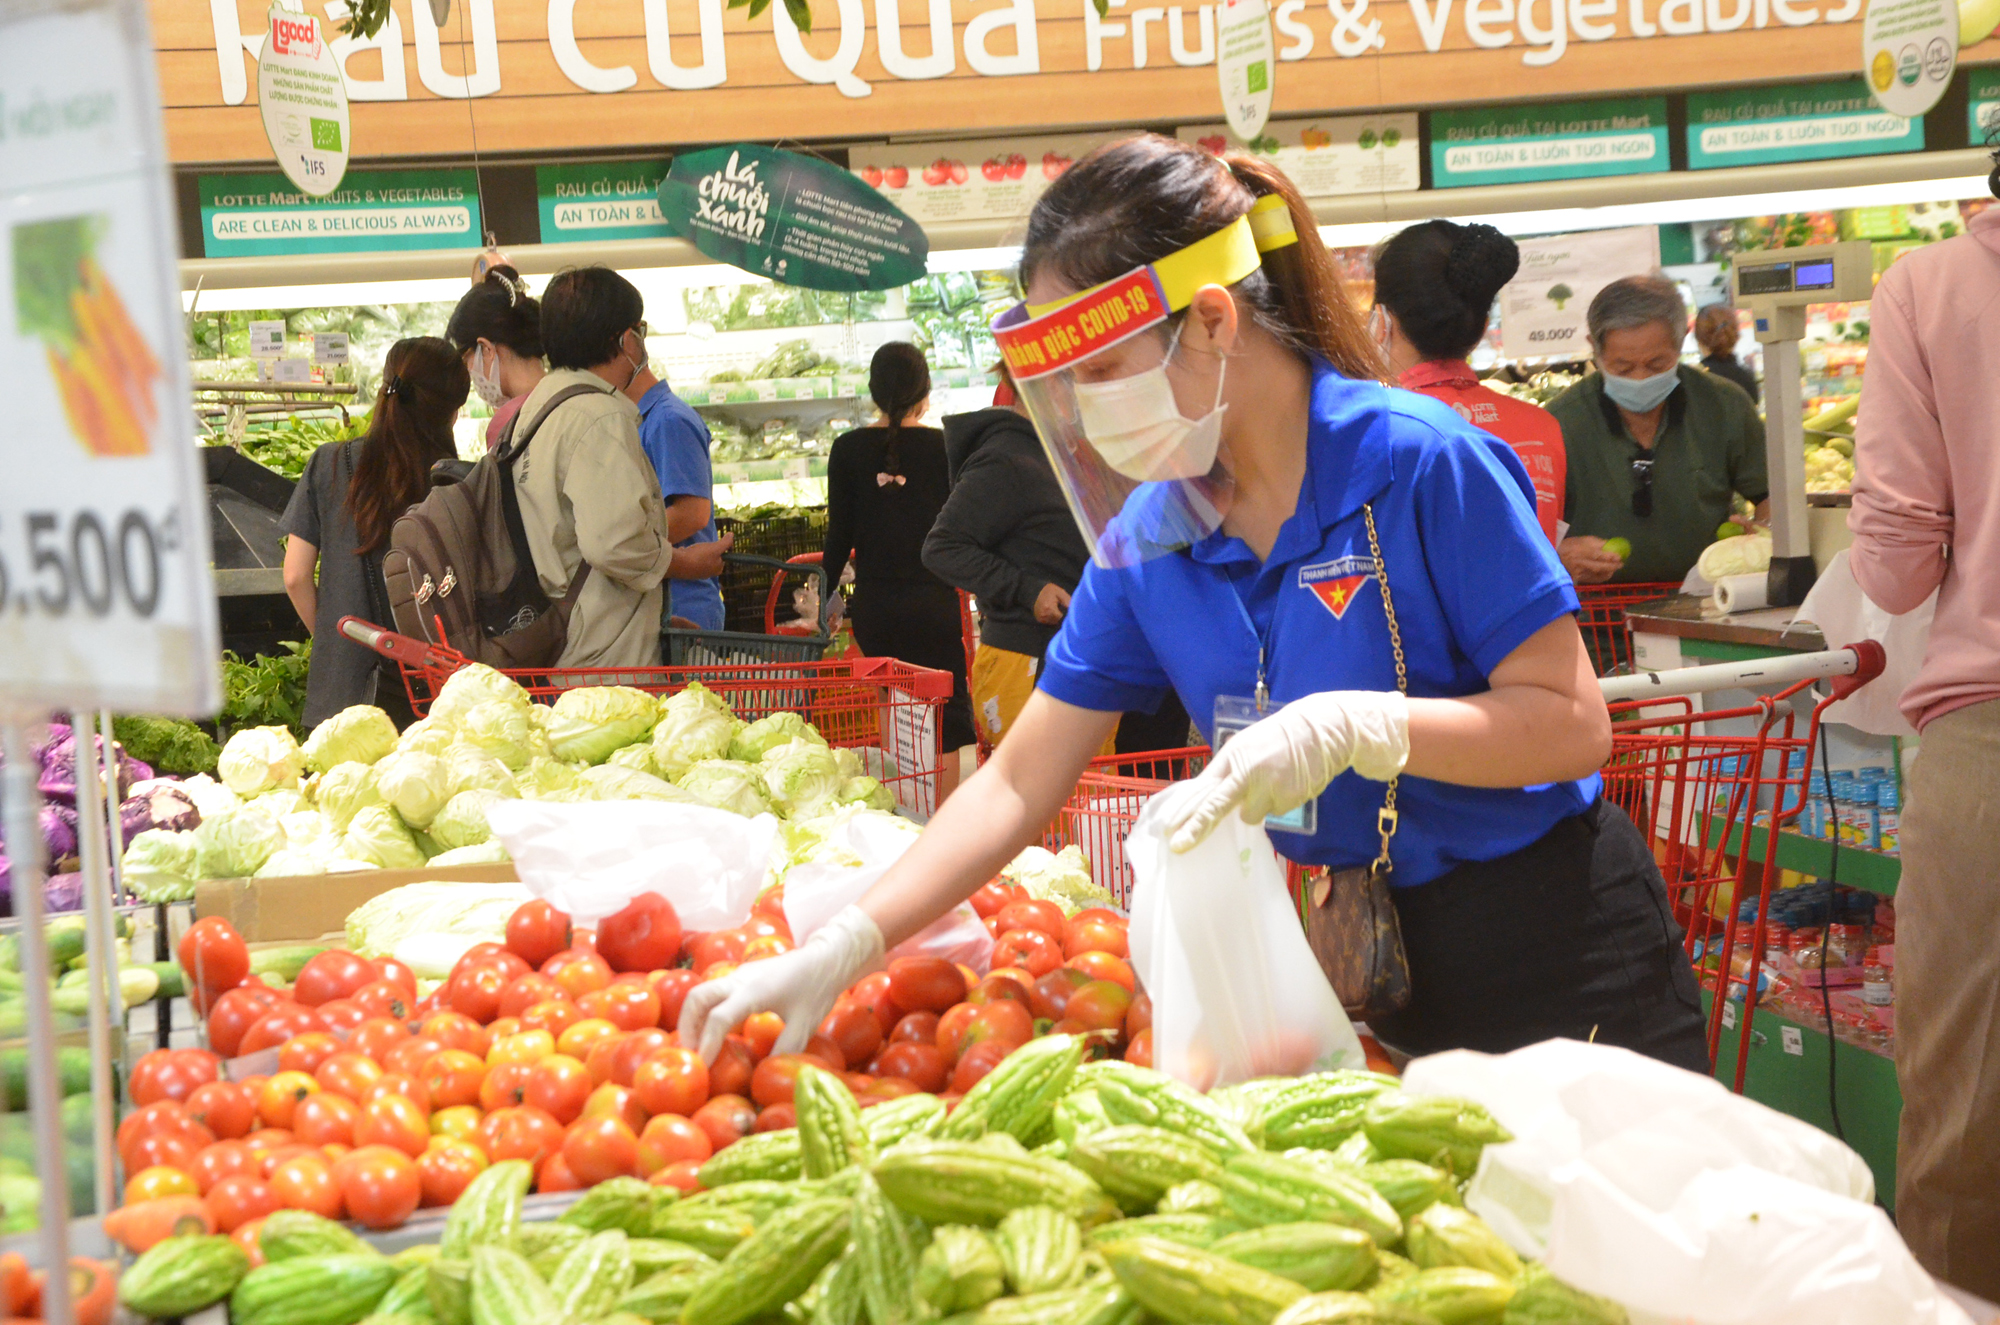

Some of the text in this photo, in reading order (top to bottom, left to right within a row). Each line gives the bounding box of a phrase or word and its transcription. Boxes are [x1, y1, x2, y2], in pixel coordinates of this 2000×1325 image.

[1084, 0, 1314, 71] Frus
[1328, 0, 1385, 58] &
[262, 63, 280, 73] LOTTE
[1815, 98, 1865, 113] LOTTE
[1446, 126, 1475, 141] RAU
[1560, 118, 1609, 133] LOTTE
[1612, 114, 1650, 129] Mart
[1708, 132, 1726, 146] AN
[1732, 127, 1769, 144] TOÀN
[1867, 117, 1904, 133] NGON
[1452, 152, 1471, 166] AN
[1477, 147, 1513, 164] TOÀN
[1612, 140, 1649, 154] NGON
[310, 160, 325, 175] IFS
[726, 150, 759, 187] Lá
[556, 182, 586, 197] RAU
[592, 177, 611, 196] CỦ
[616, 175, 648, 196] QUẢ
[699, 171, 769, 215] chuối
[214, 195, 266, 207] LOTTE
[270, 192, 309, 205] Mart
[366, 190, 374, 202] &
[379, 187, 464, 202] VEGETABLES
[801, 189, 823, 202] LOTTE
[823, 195, 840, 207] Mart
[852, 204, 876, 220] phong
[561, 208, 582, 223] AN
[588, 204, 630, 222] TOÀN
[636, 206, 645, 219] &
[835, 210, 847, 219] rau
[218, 214, 464, 234] ARE CLEAN & DELICIOUS ALWAYS
[1043, 324, 1081, 360] giặc
[1078, 285, 1150, 340] COVID-19
[1471, 403, 1497, 411] LOTTE
[1475, 411, 1500, 423] Mart
[1303, 569, 1327, 580] THANH
[1356, 561, 1375, 571] NAM
